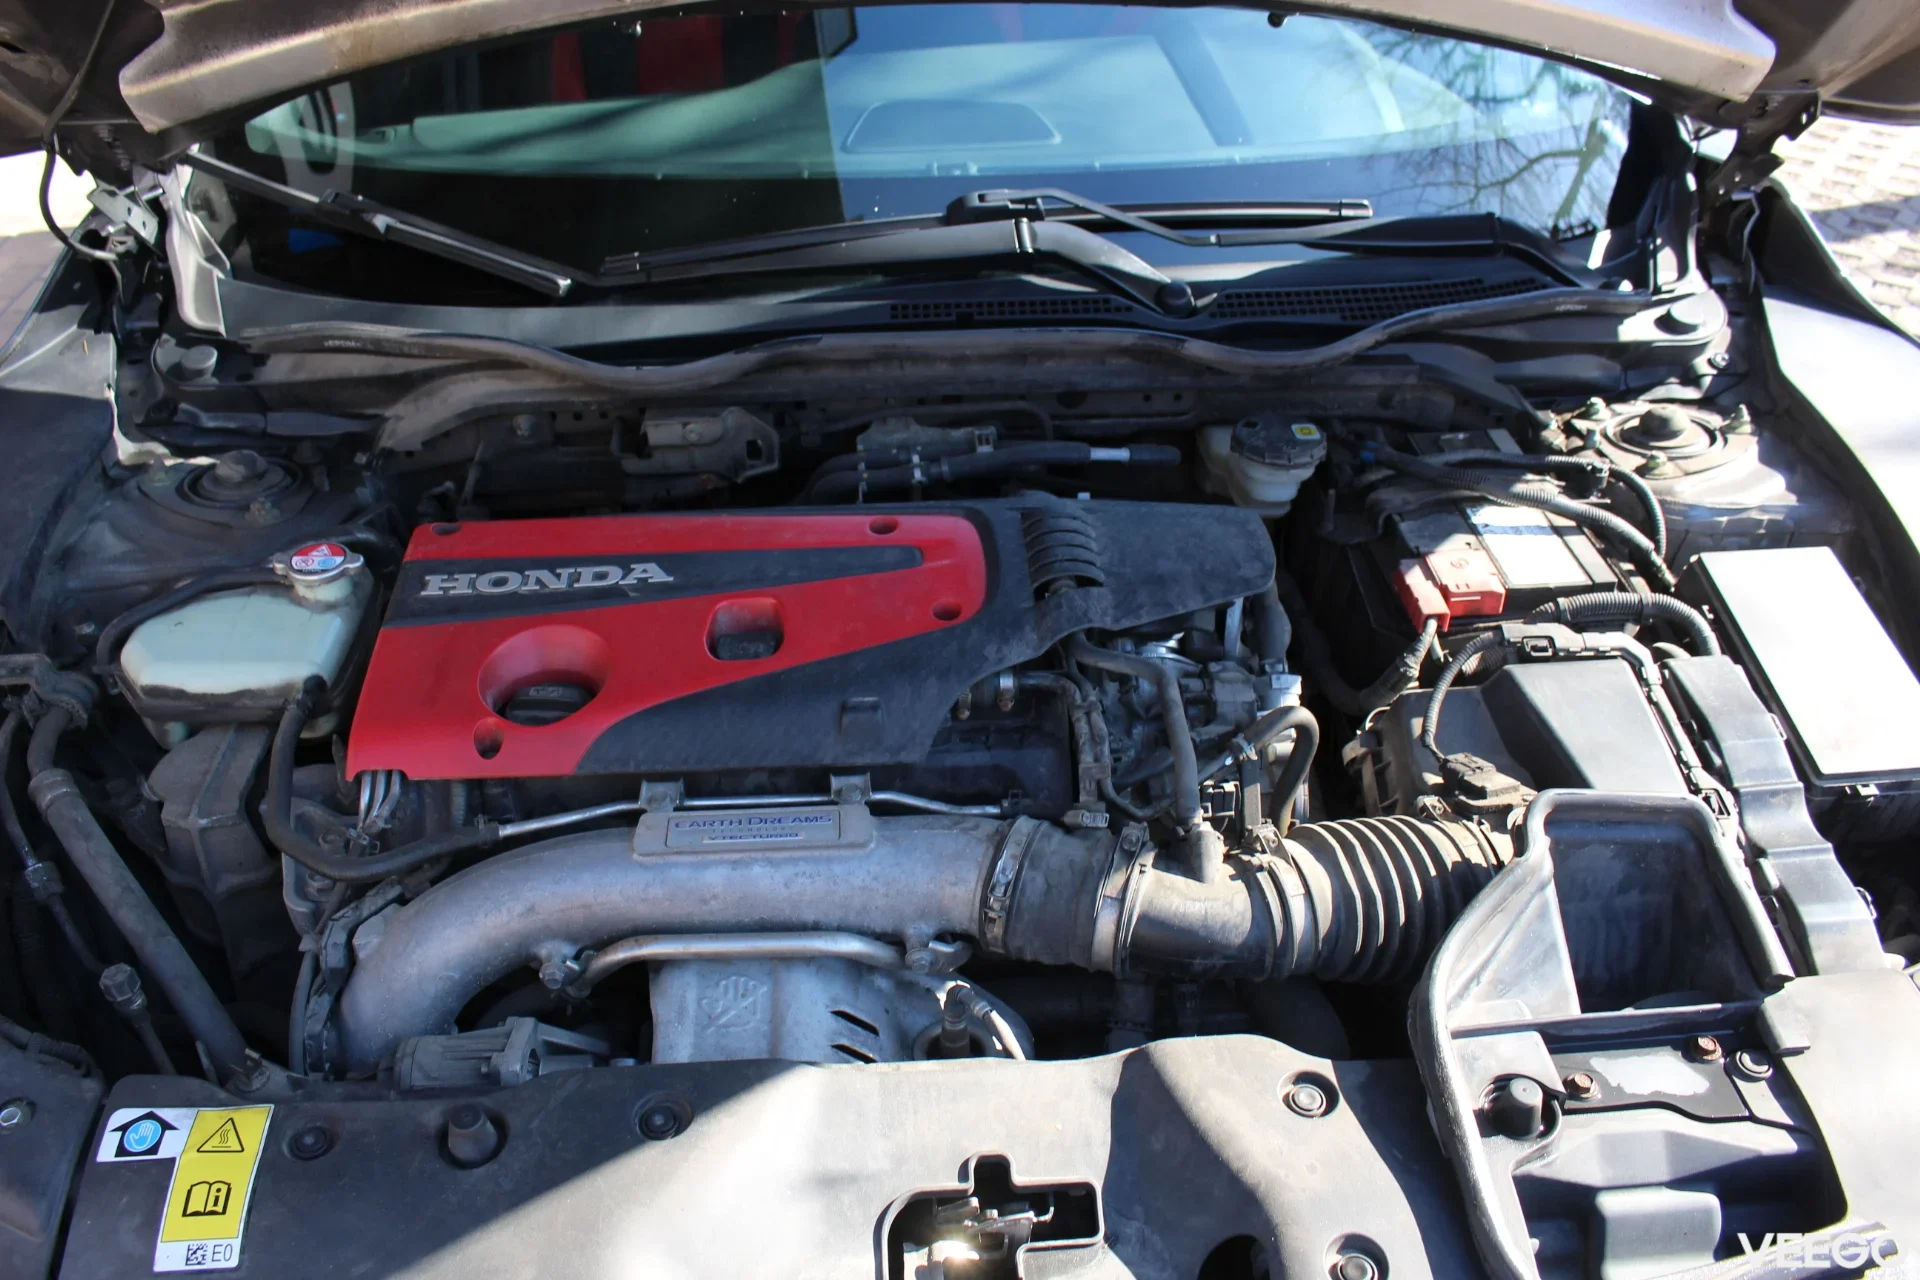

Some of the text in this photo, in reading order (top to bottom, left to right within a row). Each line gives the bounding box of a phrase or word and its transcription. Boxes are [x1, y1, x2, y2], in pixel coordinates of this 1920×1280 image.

[420, 562, 674, 596] HONDA
[675, 814, 832, 829] EARTH DREAMS
